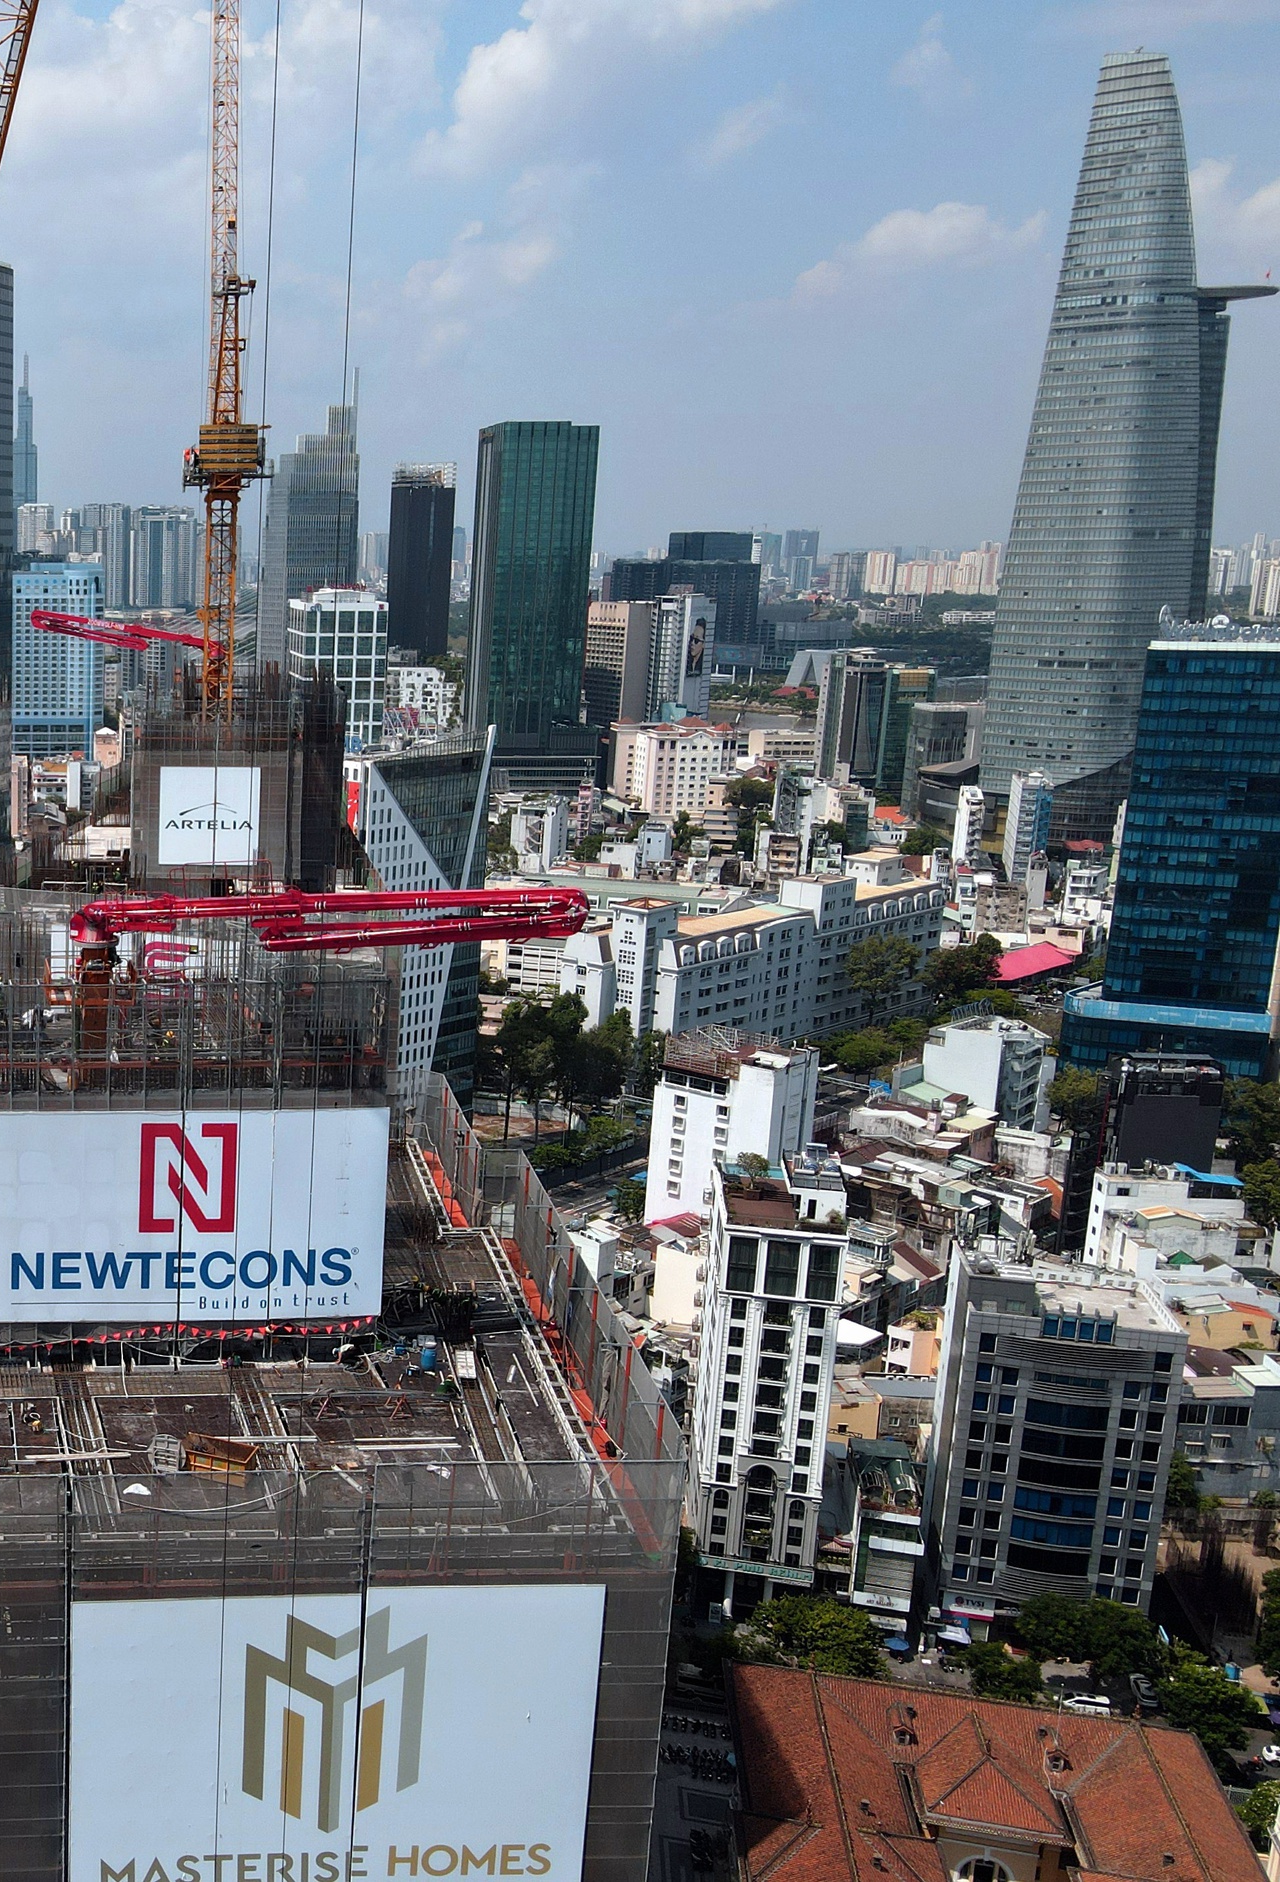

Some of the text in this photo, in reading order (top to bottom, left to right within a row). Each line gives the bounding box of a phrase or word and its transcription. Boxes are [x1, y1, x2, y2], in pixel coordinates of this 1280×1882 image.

[164, 819, 254, 831] ARTELIA
[199, 1291, 351, 1310] Build on trust
[387, 1842, 552, 1877] HOMES
